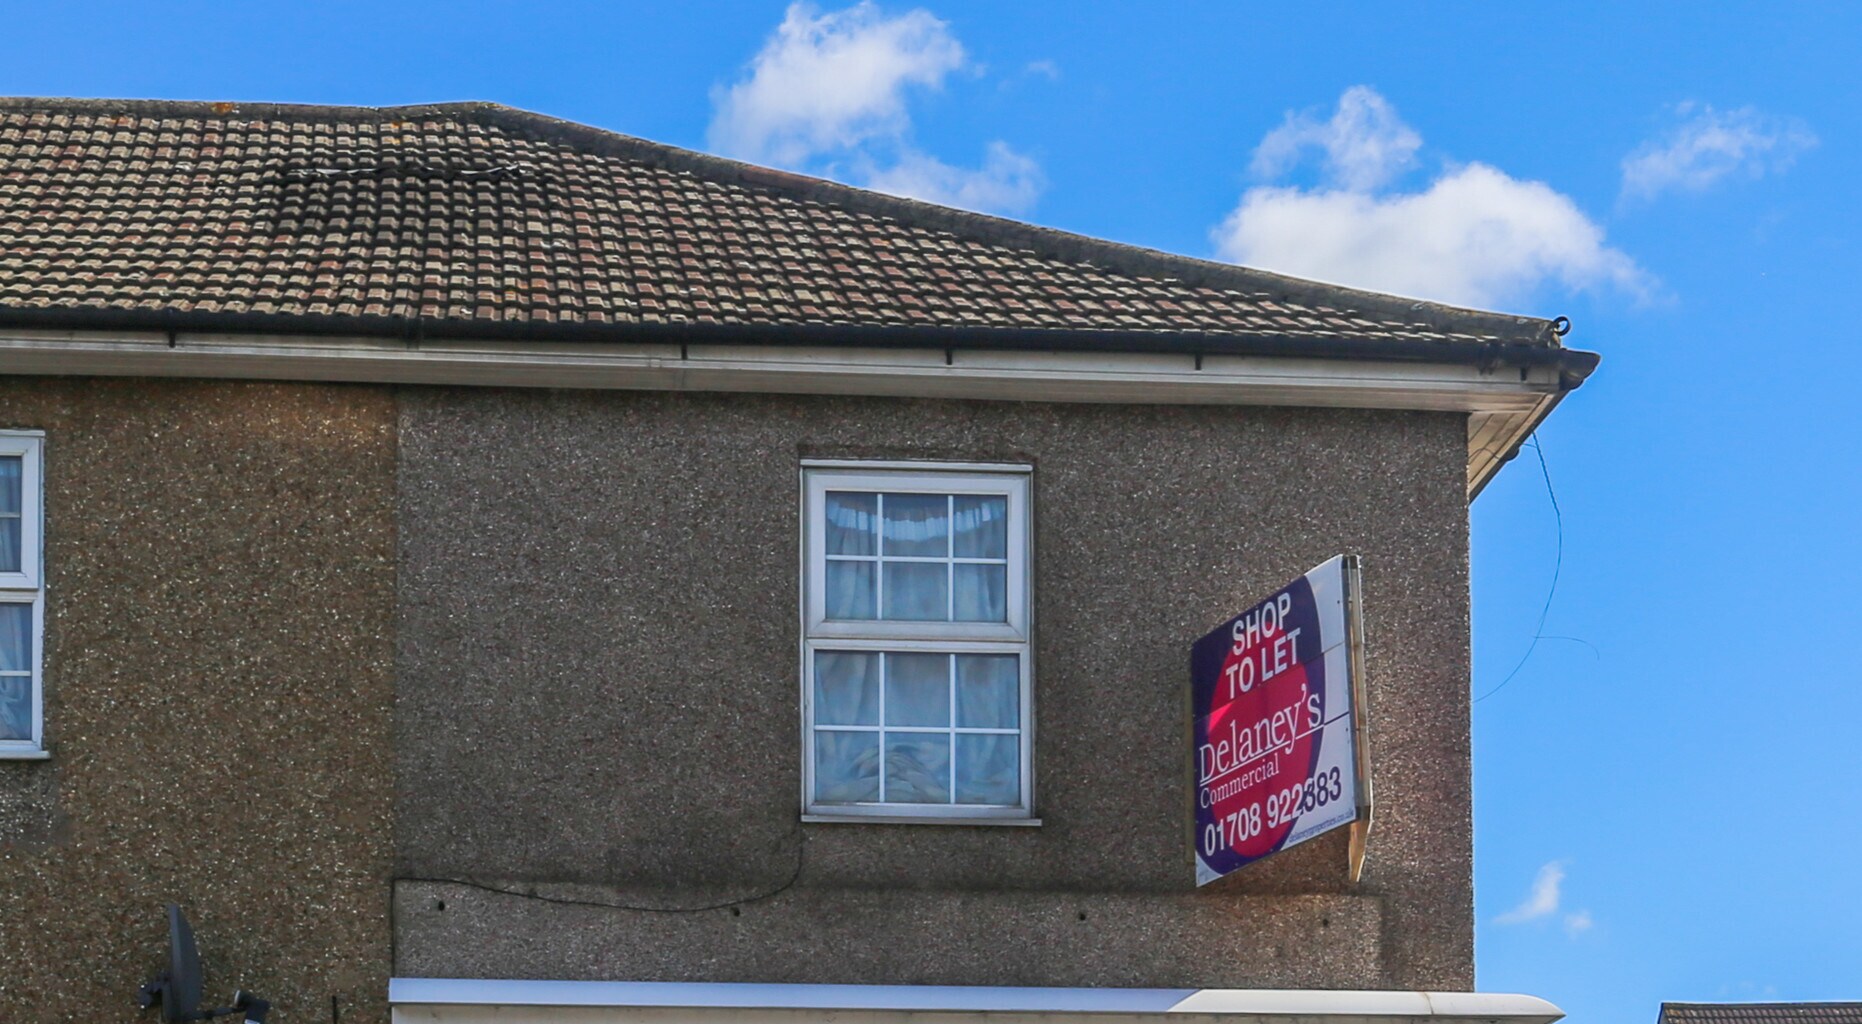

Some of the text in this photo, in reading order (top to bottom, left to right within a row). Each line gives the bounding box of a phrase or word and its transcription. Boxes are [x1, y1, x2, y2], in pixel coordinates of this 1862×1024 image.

[1232, 592, 1291, 656] SHOP
[1226, 627, 1300, 699] TO LET
[1200, 682, 1322, 782] Delaney's
[1200, 752, 1280, 809] Commercial
[1204, 765, 1342, 857] 01708 922383
